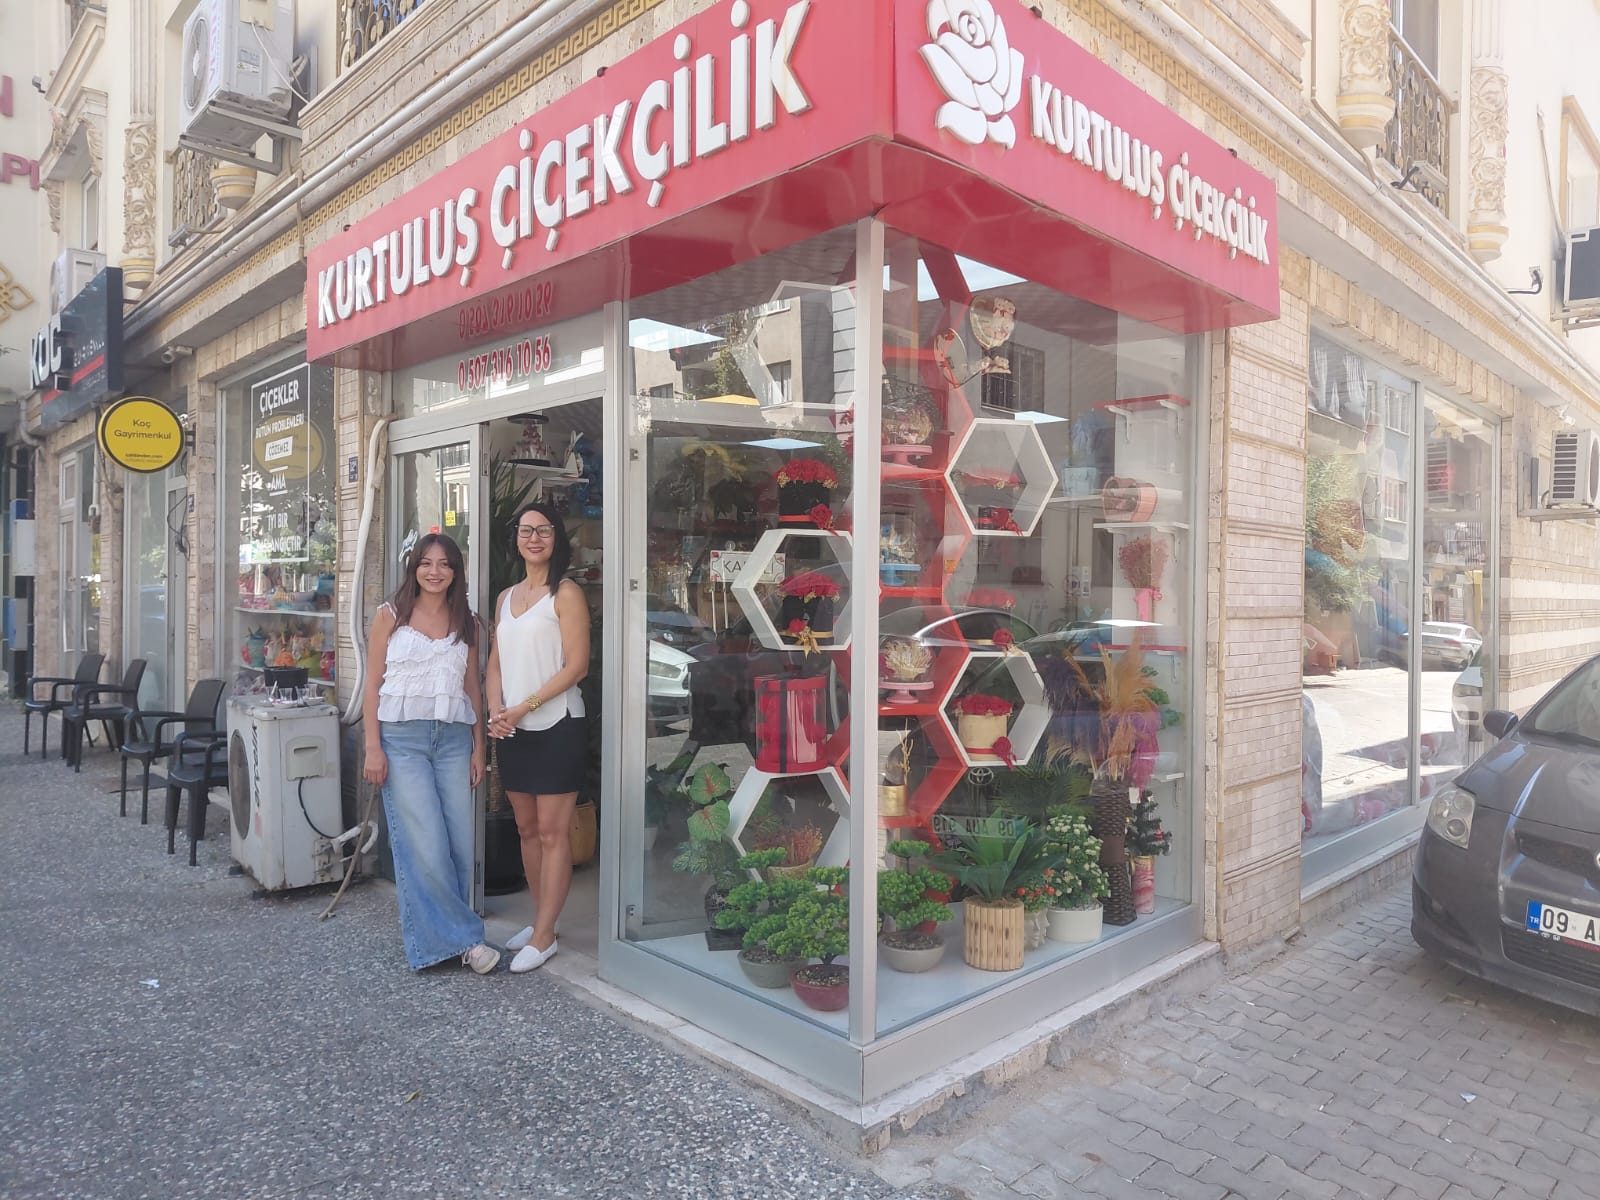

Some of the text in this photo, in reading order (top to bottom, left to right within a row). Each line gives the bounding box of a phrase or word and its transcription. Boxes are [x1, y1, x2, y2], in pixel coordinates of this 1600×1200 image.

[0, 152, 40, 191] PI
[318, 0, 814, 329] KURTULUŞ ÇİÇEKÇİLİK
[1030, 74, 1270, 265] KURTULUŞ ÇİÇEKÇİLİK
[458, 333, 551, 393] 0 507 316 10 56
[260, 379, 300, 419] ÇİÇEKLER
[114, 429, 172, 440] Gayrimenkul
[132, 419, 151, 428] Koç
[271, 472, 287, 491] AMA
[1543, 909, 1600, 942] 09 A
